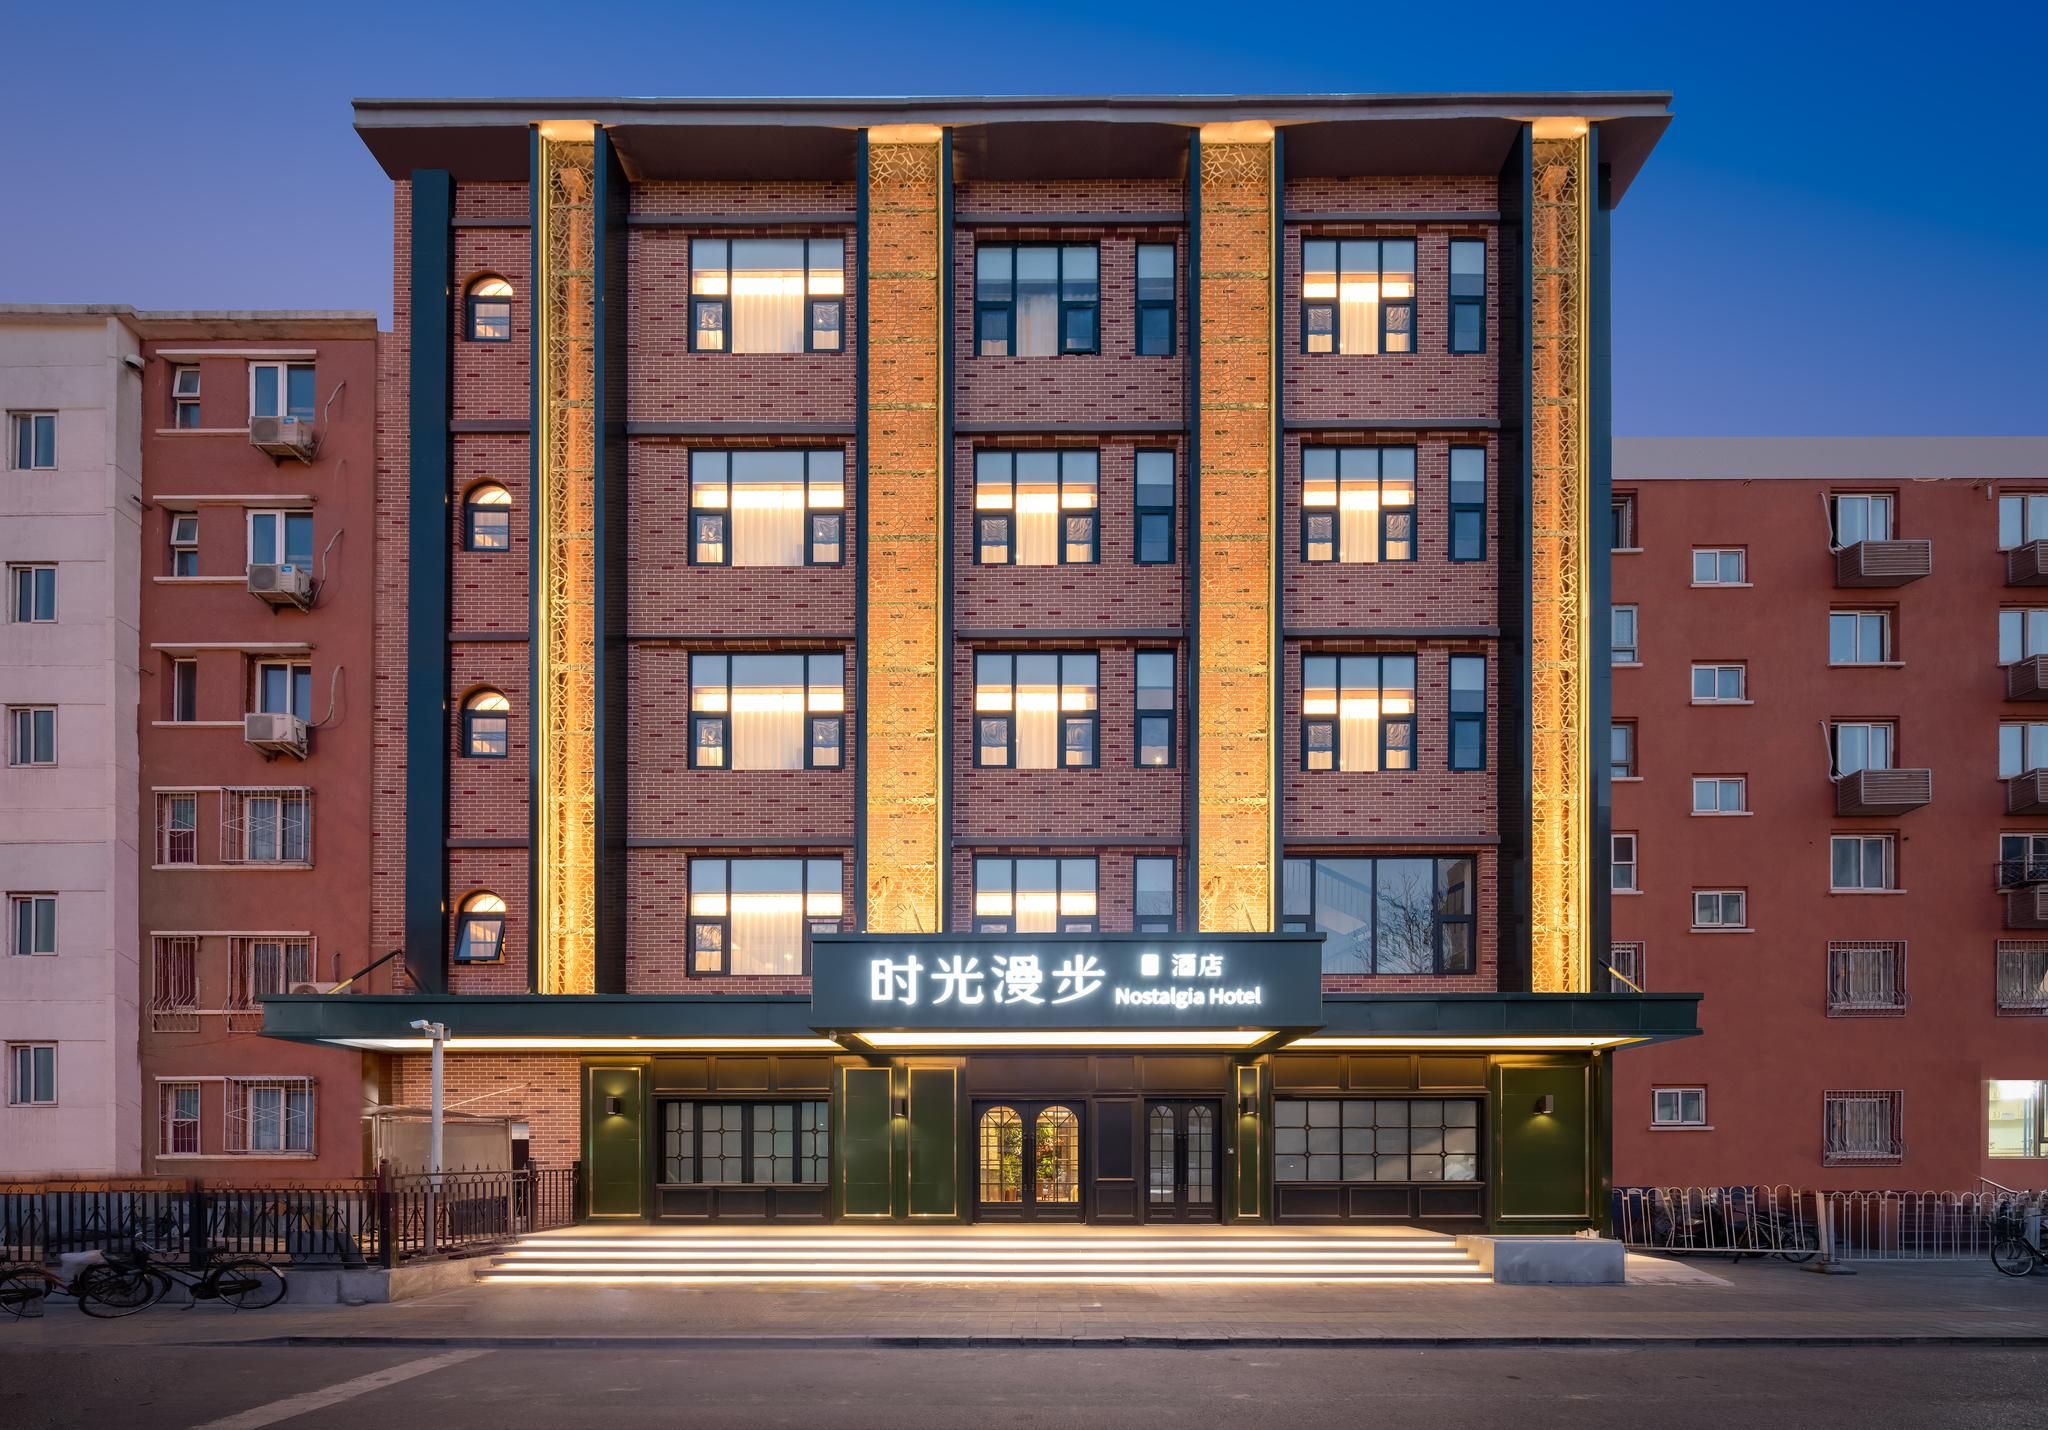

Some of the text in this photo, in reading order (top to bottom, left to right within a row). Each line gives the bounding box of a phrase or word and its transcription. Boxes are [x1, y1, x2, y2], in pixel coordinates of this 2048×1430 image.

[1171, 952, 1224, 978] 酒店
[870, 953, 1106, 1006] 时光漫步
[1114, 985, 1263, 1010] Nostalgia Hotel
